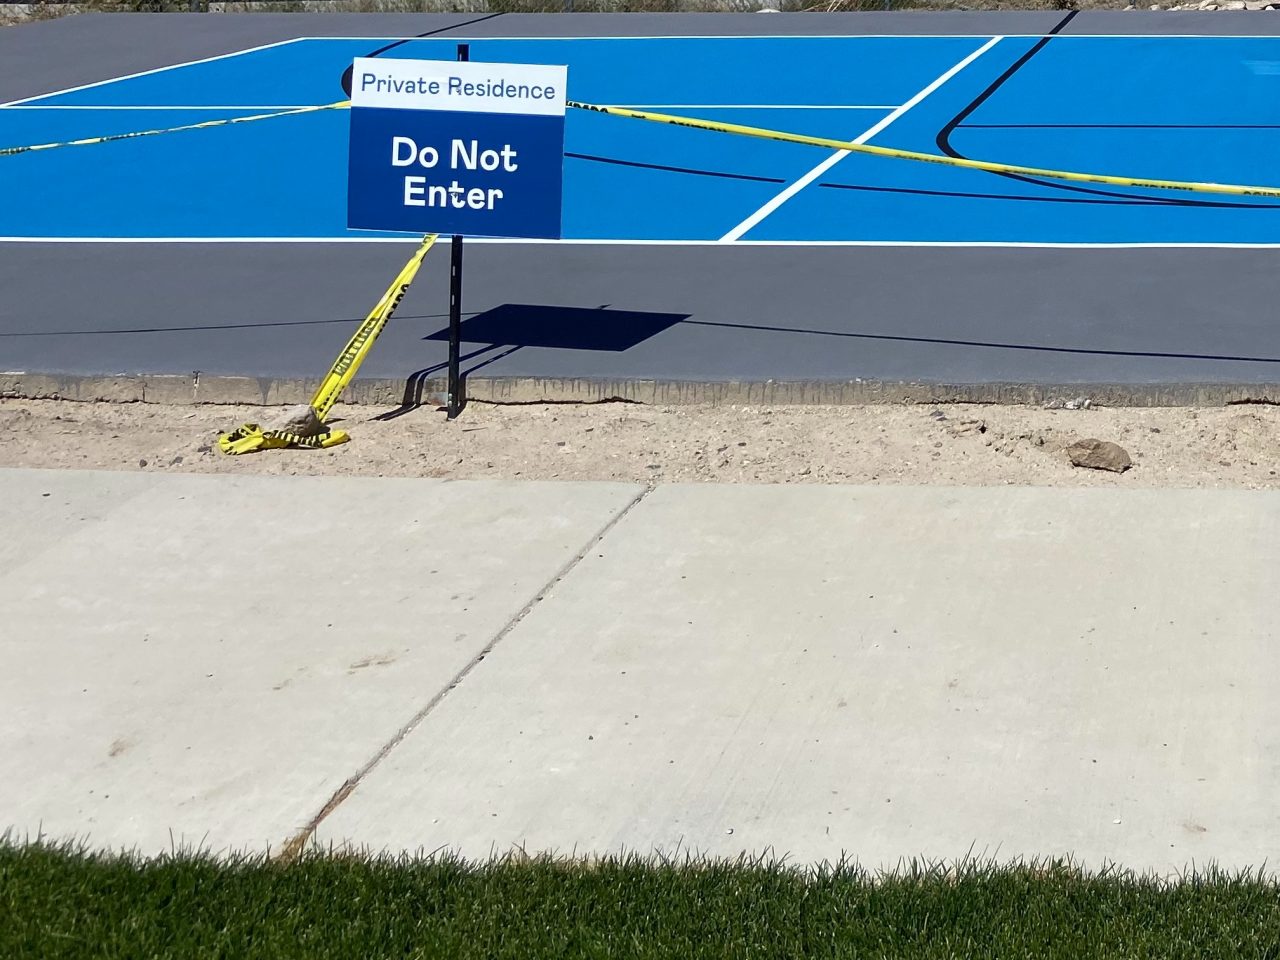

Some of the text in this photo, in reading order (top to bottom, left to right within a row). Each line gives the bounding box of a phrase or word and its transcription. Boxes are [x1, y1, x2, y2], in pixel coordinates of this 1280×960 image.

[361, 73, 556, 100] Private Residence
[392, 136, 518, 172] Do Not
[404, 176, 503, 210] Enter
